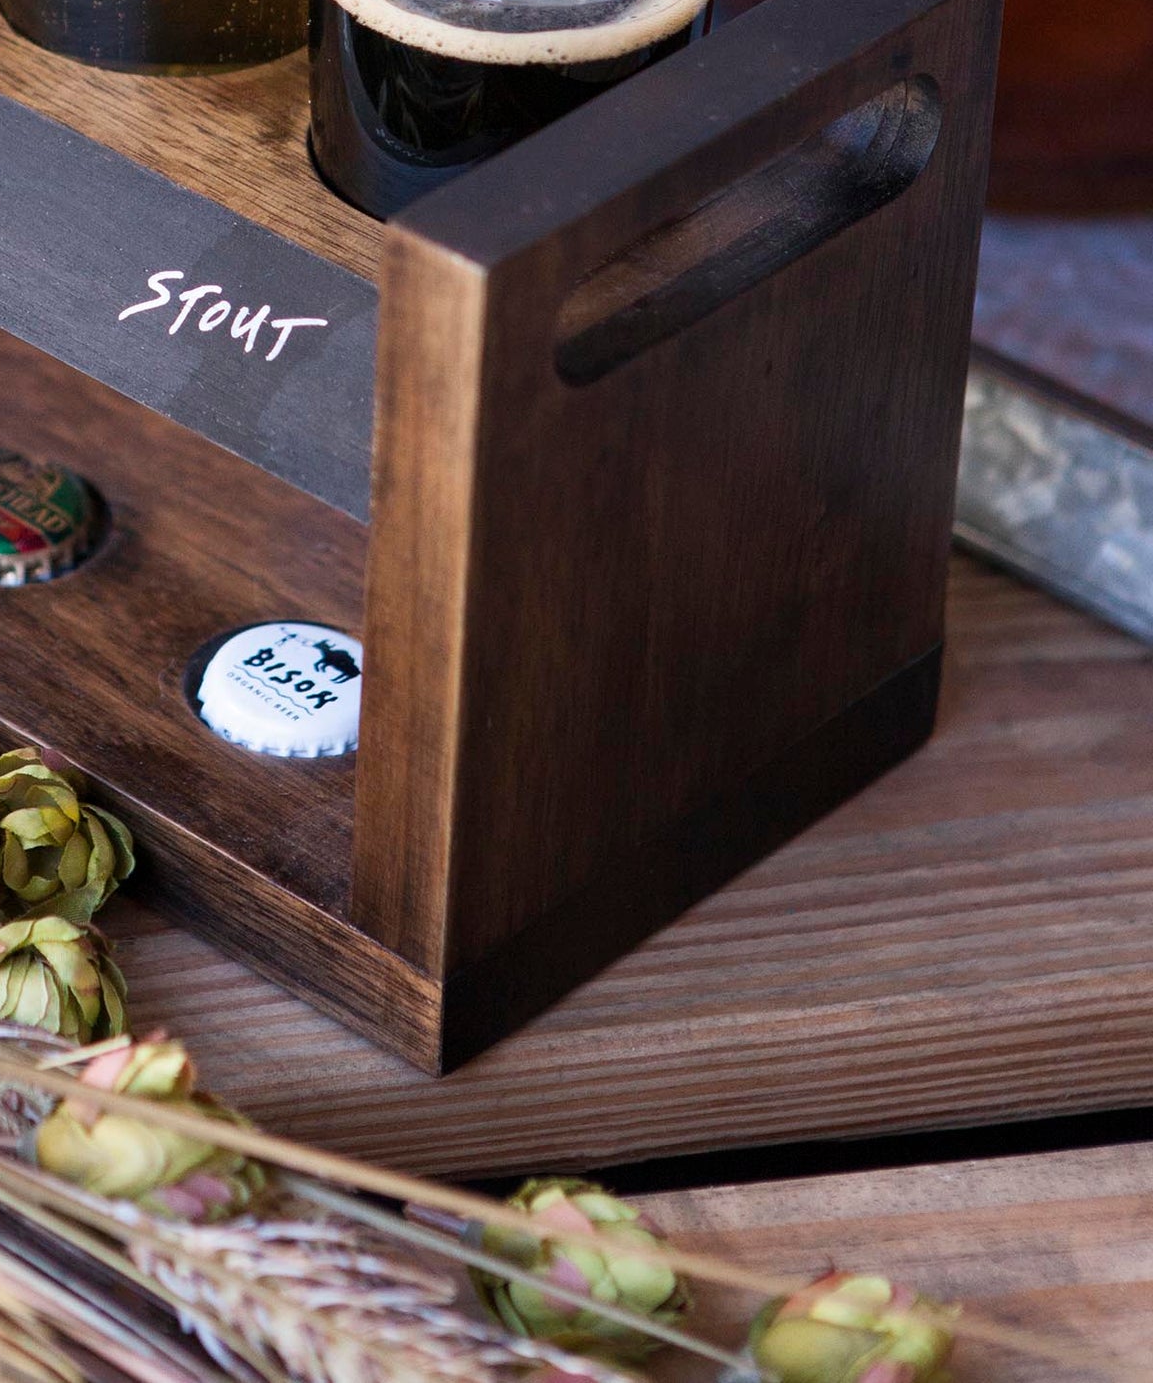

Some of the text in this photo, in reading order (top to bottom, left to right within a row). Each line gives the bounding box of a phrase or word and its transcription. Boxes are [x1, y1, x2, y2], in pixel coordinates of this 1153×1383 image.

[118, 270, 329, 361] STOUT
[225, 670, 301, 722] ORGANIC BEER
[242, 647, 339, 710] BISON
